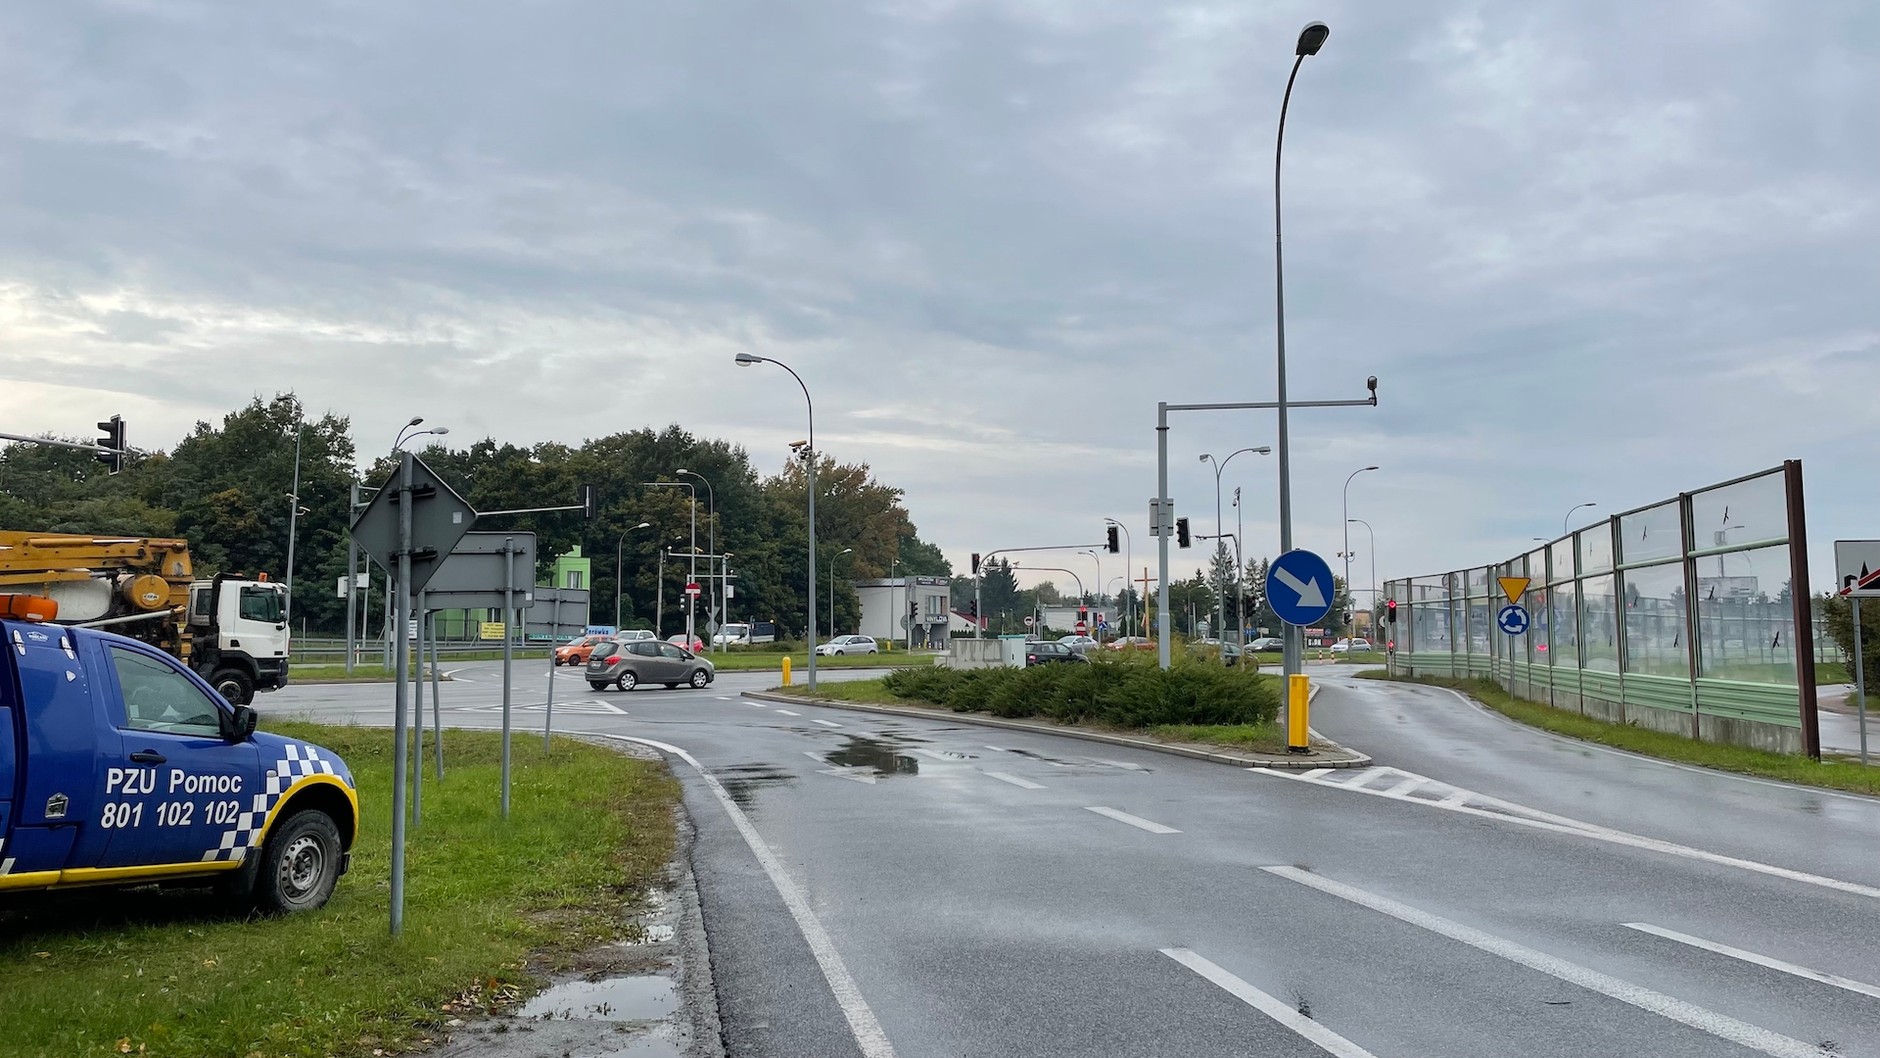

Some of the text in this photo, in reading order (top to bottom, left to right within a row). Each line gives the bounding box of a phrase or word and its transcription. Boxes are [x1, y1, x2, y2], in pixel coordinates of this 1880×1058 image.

[105, 768, 243, 794] PZU Pomoc
[101, 800, 240, 829] 801 102 102
